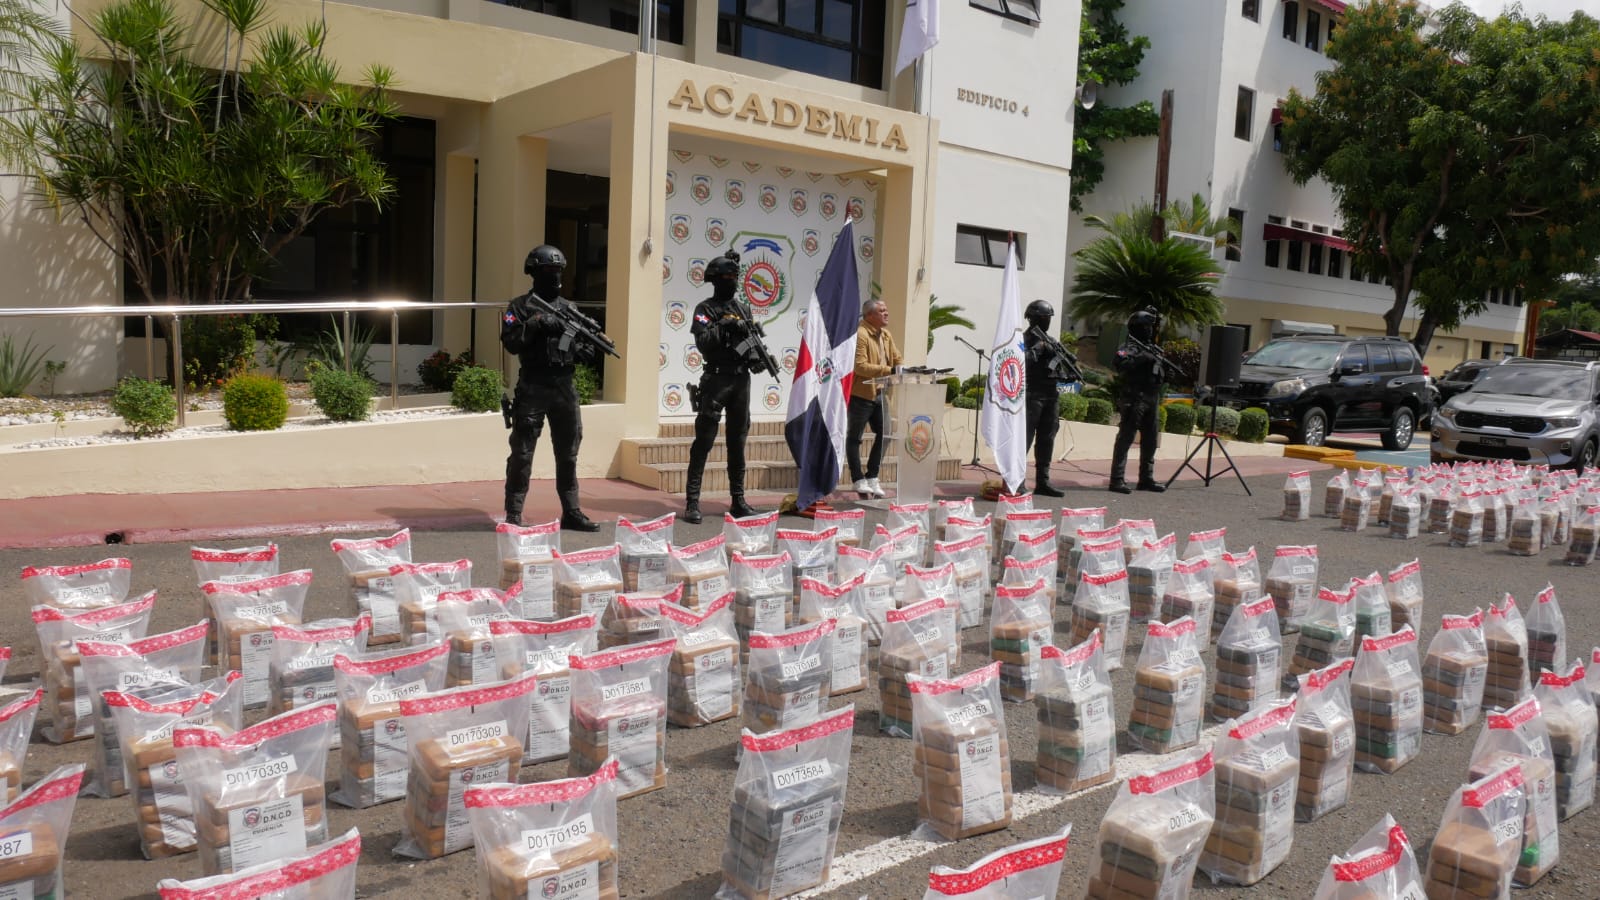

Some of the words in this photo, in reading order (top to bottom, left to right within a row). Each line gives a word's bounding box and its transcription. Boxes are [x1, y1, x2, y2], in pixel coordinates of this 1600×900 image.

[956, 87, 1018, 114] EDIFICIO
[1022, 105, 1030, 118] 4
[668, 79, 909, 152] ACADEMIA
[604, 681, 645, 699] D0173581
[451, 726, 502, 745] D0170309
[226, 761, 289, 786] D0170339
[777, 764, 825, 786] D0173584
[262, 809, 293, 825] D.N.C.D
[527, 820, 588, 850] D0170195
[560, 878, 588, 895] D.N.C.D
